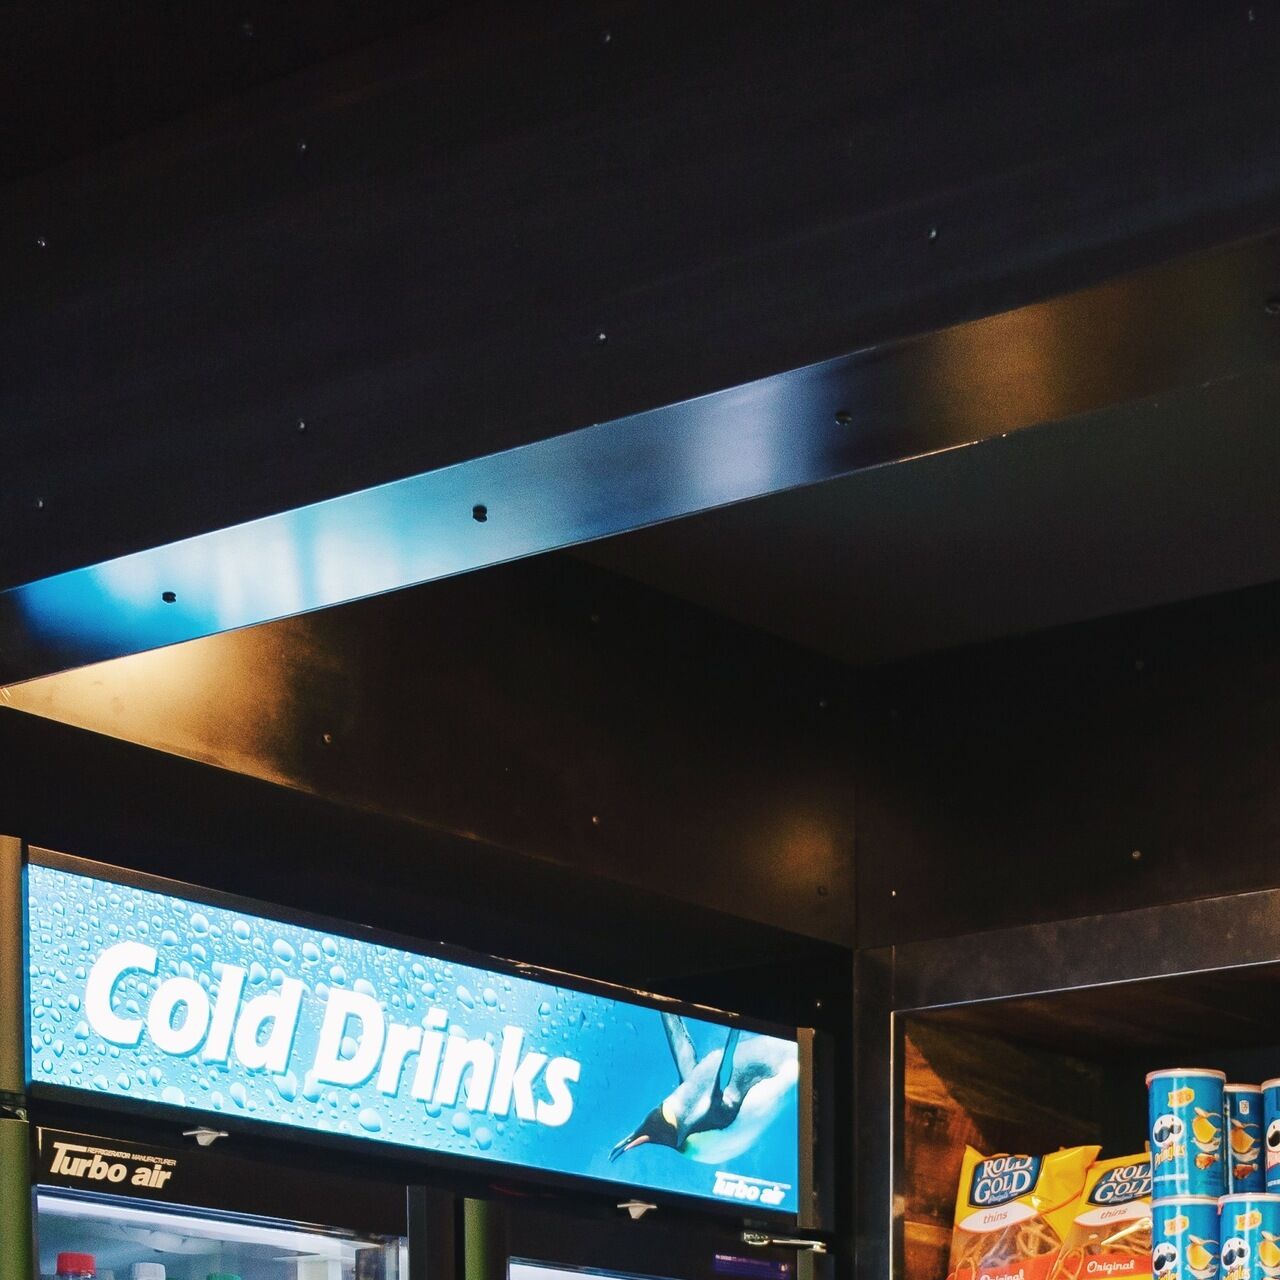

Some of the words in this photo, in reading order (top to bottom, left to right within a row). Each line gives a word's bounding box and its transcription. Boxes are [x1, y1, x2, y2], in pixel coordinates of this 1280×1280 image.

[84, 939, 310, 1077] Cold
[318, 989, 581, 1129] Drinks
[50, 1141, 128, 1182] Turbo
[131, 1165, 172, 1188] air
[87, 1147, 130, 1159] REFRIGERATOR
[132, 1153, 177, 1167] MANUFACTURER
[982, 1157, 1033, 1177] ROLD
[974, 1169, 1032, 1203] GOLD
[983, 1211, 1008, 1224] thins
[1100, 1208, 1127, 1219] thins
[1086, 1260, 1135, 1274] Original
